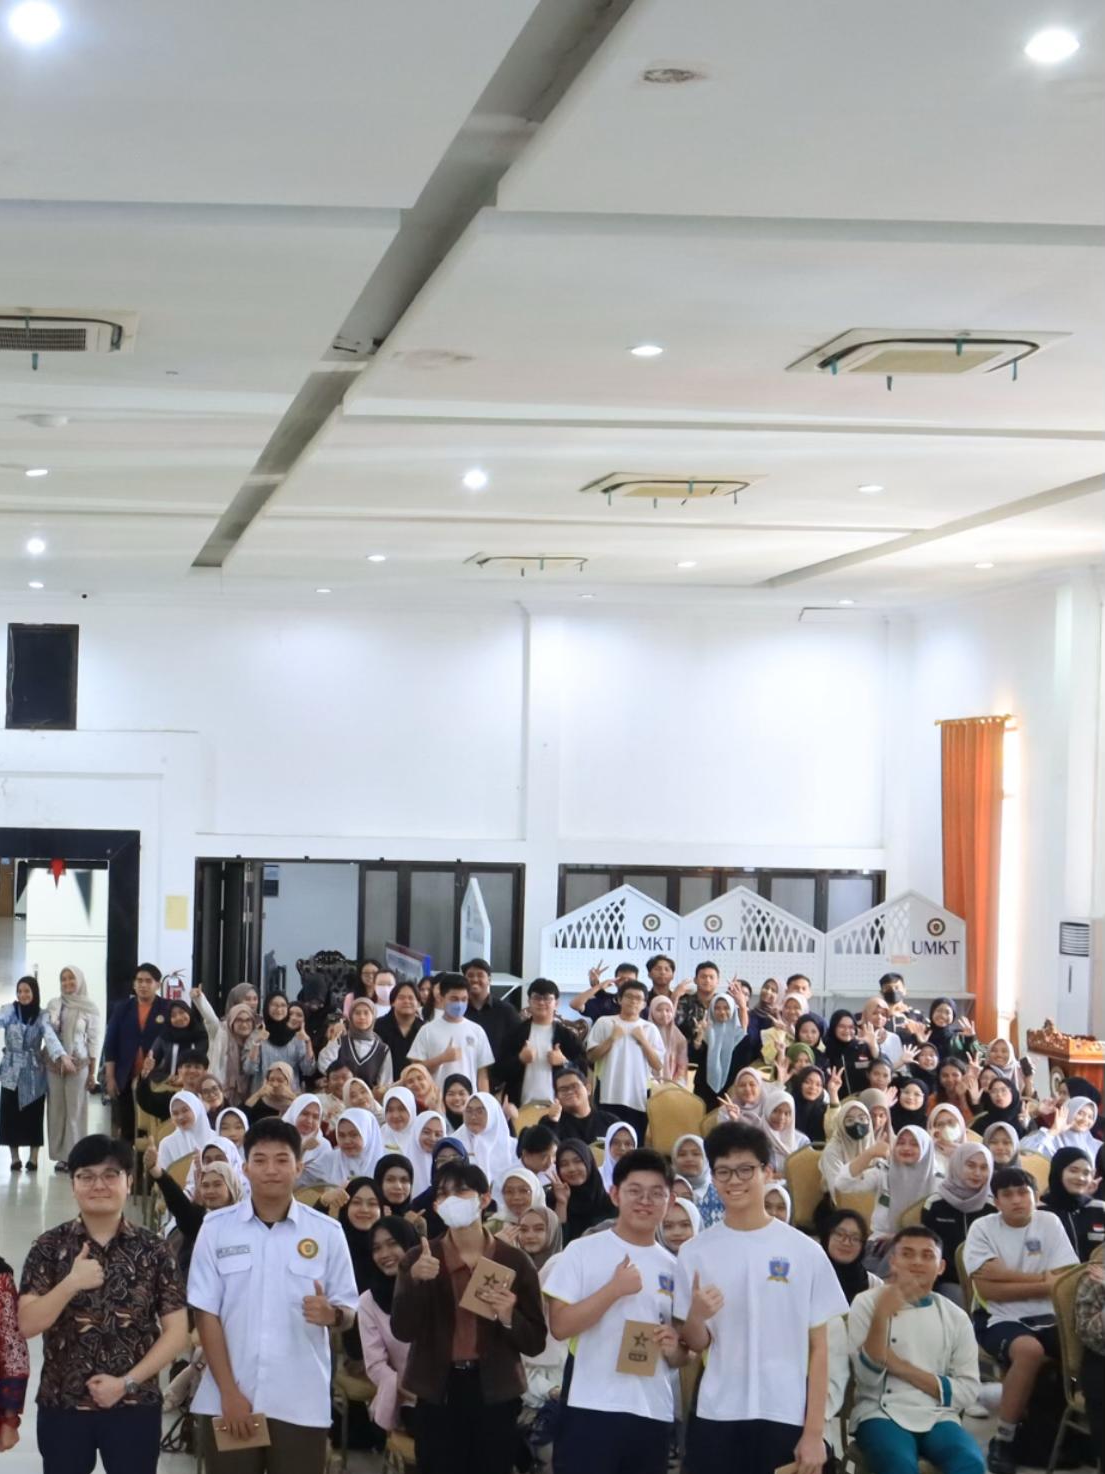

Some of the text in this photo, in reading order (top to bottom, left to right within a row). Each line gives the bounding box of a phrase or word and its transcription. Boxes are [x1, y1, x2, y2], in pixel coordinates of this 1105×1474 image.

[627, 936, 675, 951] UMKT
[689, 936, 737, 951] UMKT
[912, 940, 960, 955] UMKT
